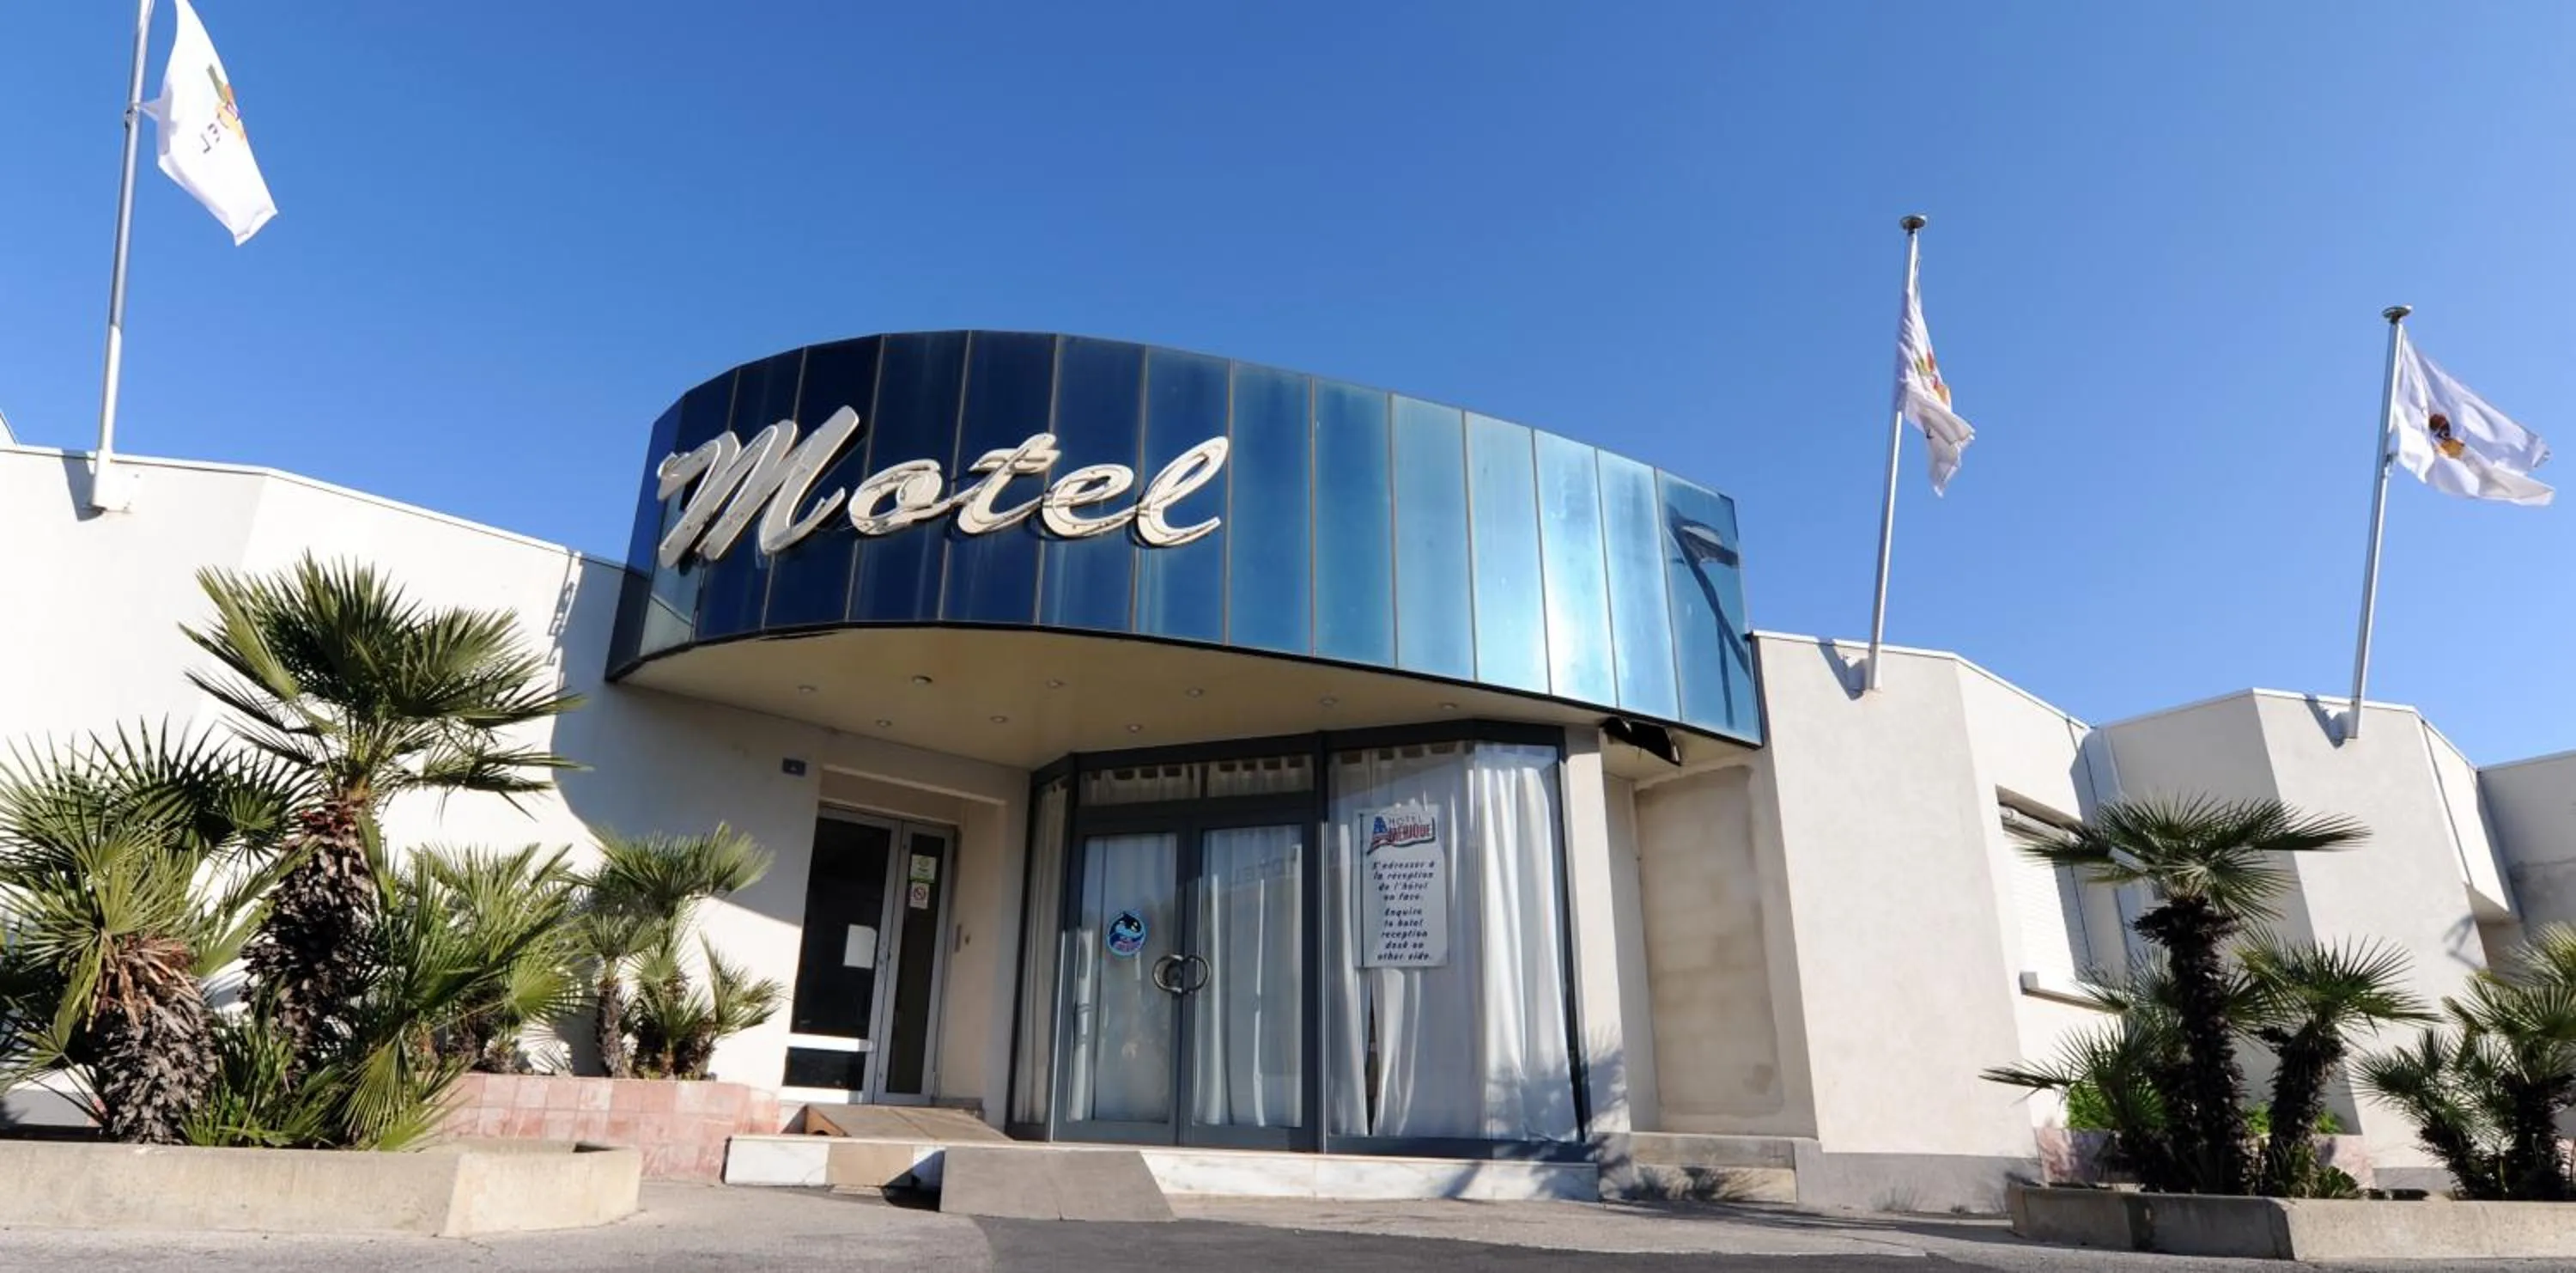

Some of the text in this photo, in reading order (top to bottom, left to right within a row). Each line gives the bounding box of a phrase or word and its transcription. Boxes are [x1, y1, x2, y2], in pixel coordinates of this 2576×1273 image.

[656, 405, 1229, 569] Motel
[1388, 815, 1424, 826] HOTEL
[1378, 882, 1389, 891] de
[1384, 908, 1422, 917] Enquire
[1381, 930, 1428, 940] reception
[1377, 952, 1403, 960] other
